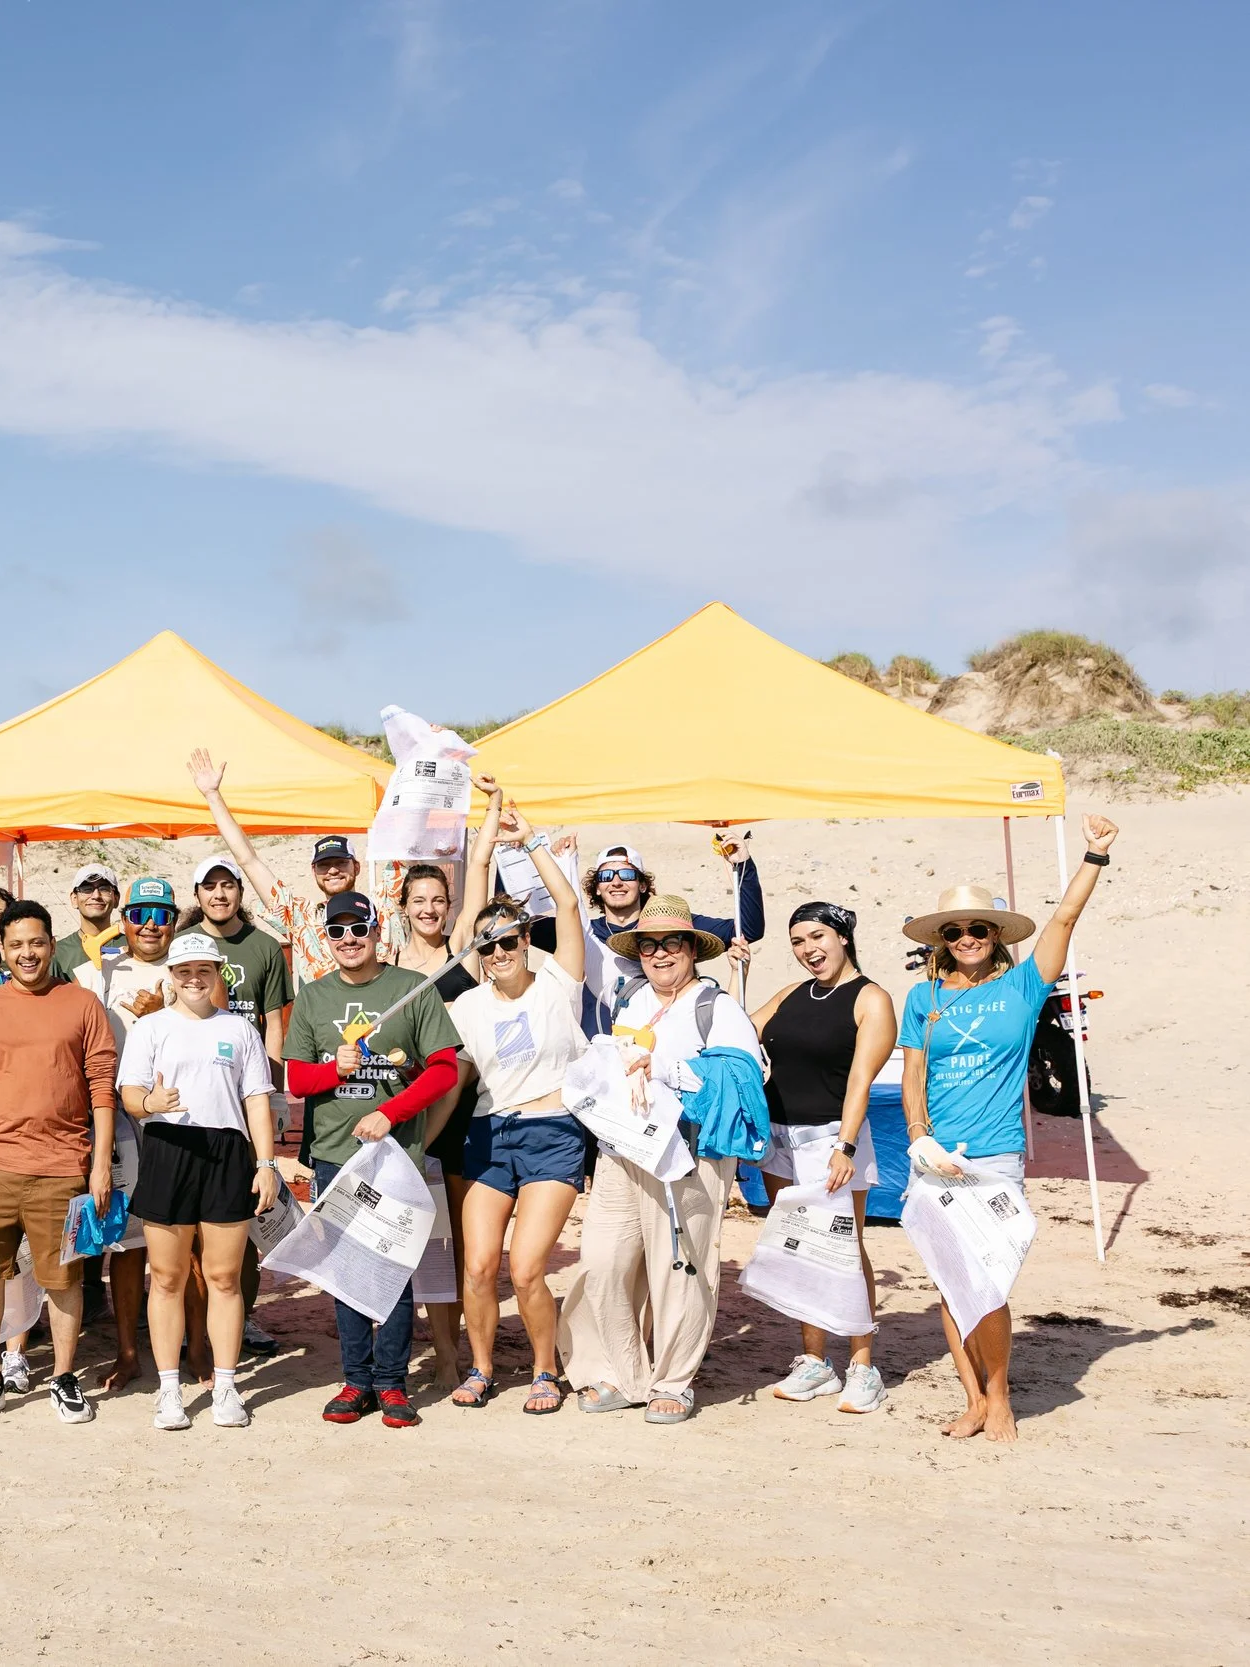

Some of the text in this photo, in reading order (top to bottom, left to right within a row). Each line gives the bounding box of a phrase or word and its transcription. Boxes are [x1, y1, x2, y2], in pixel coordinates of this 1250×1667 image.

[1011, 789, 1040, 798] Eurmax
[228, 1001, 255, 1011] exas
[950, 1053, 992, 1069] PADRE
[353, 1189, 378, 1209] Clean
[830, 1224, 852, 1236] Clean
